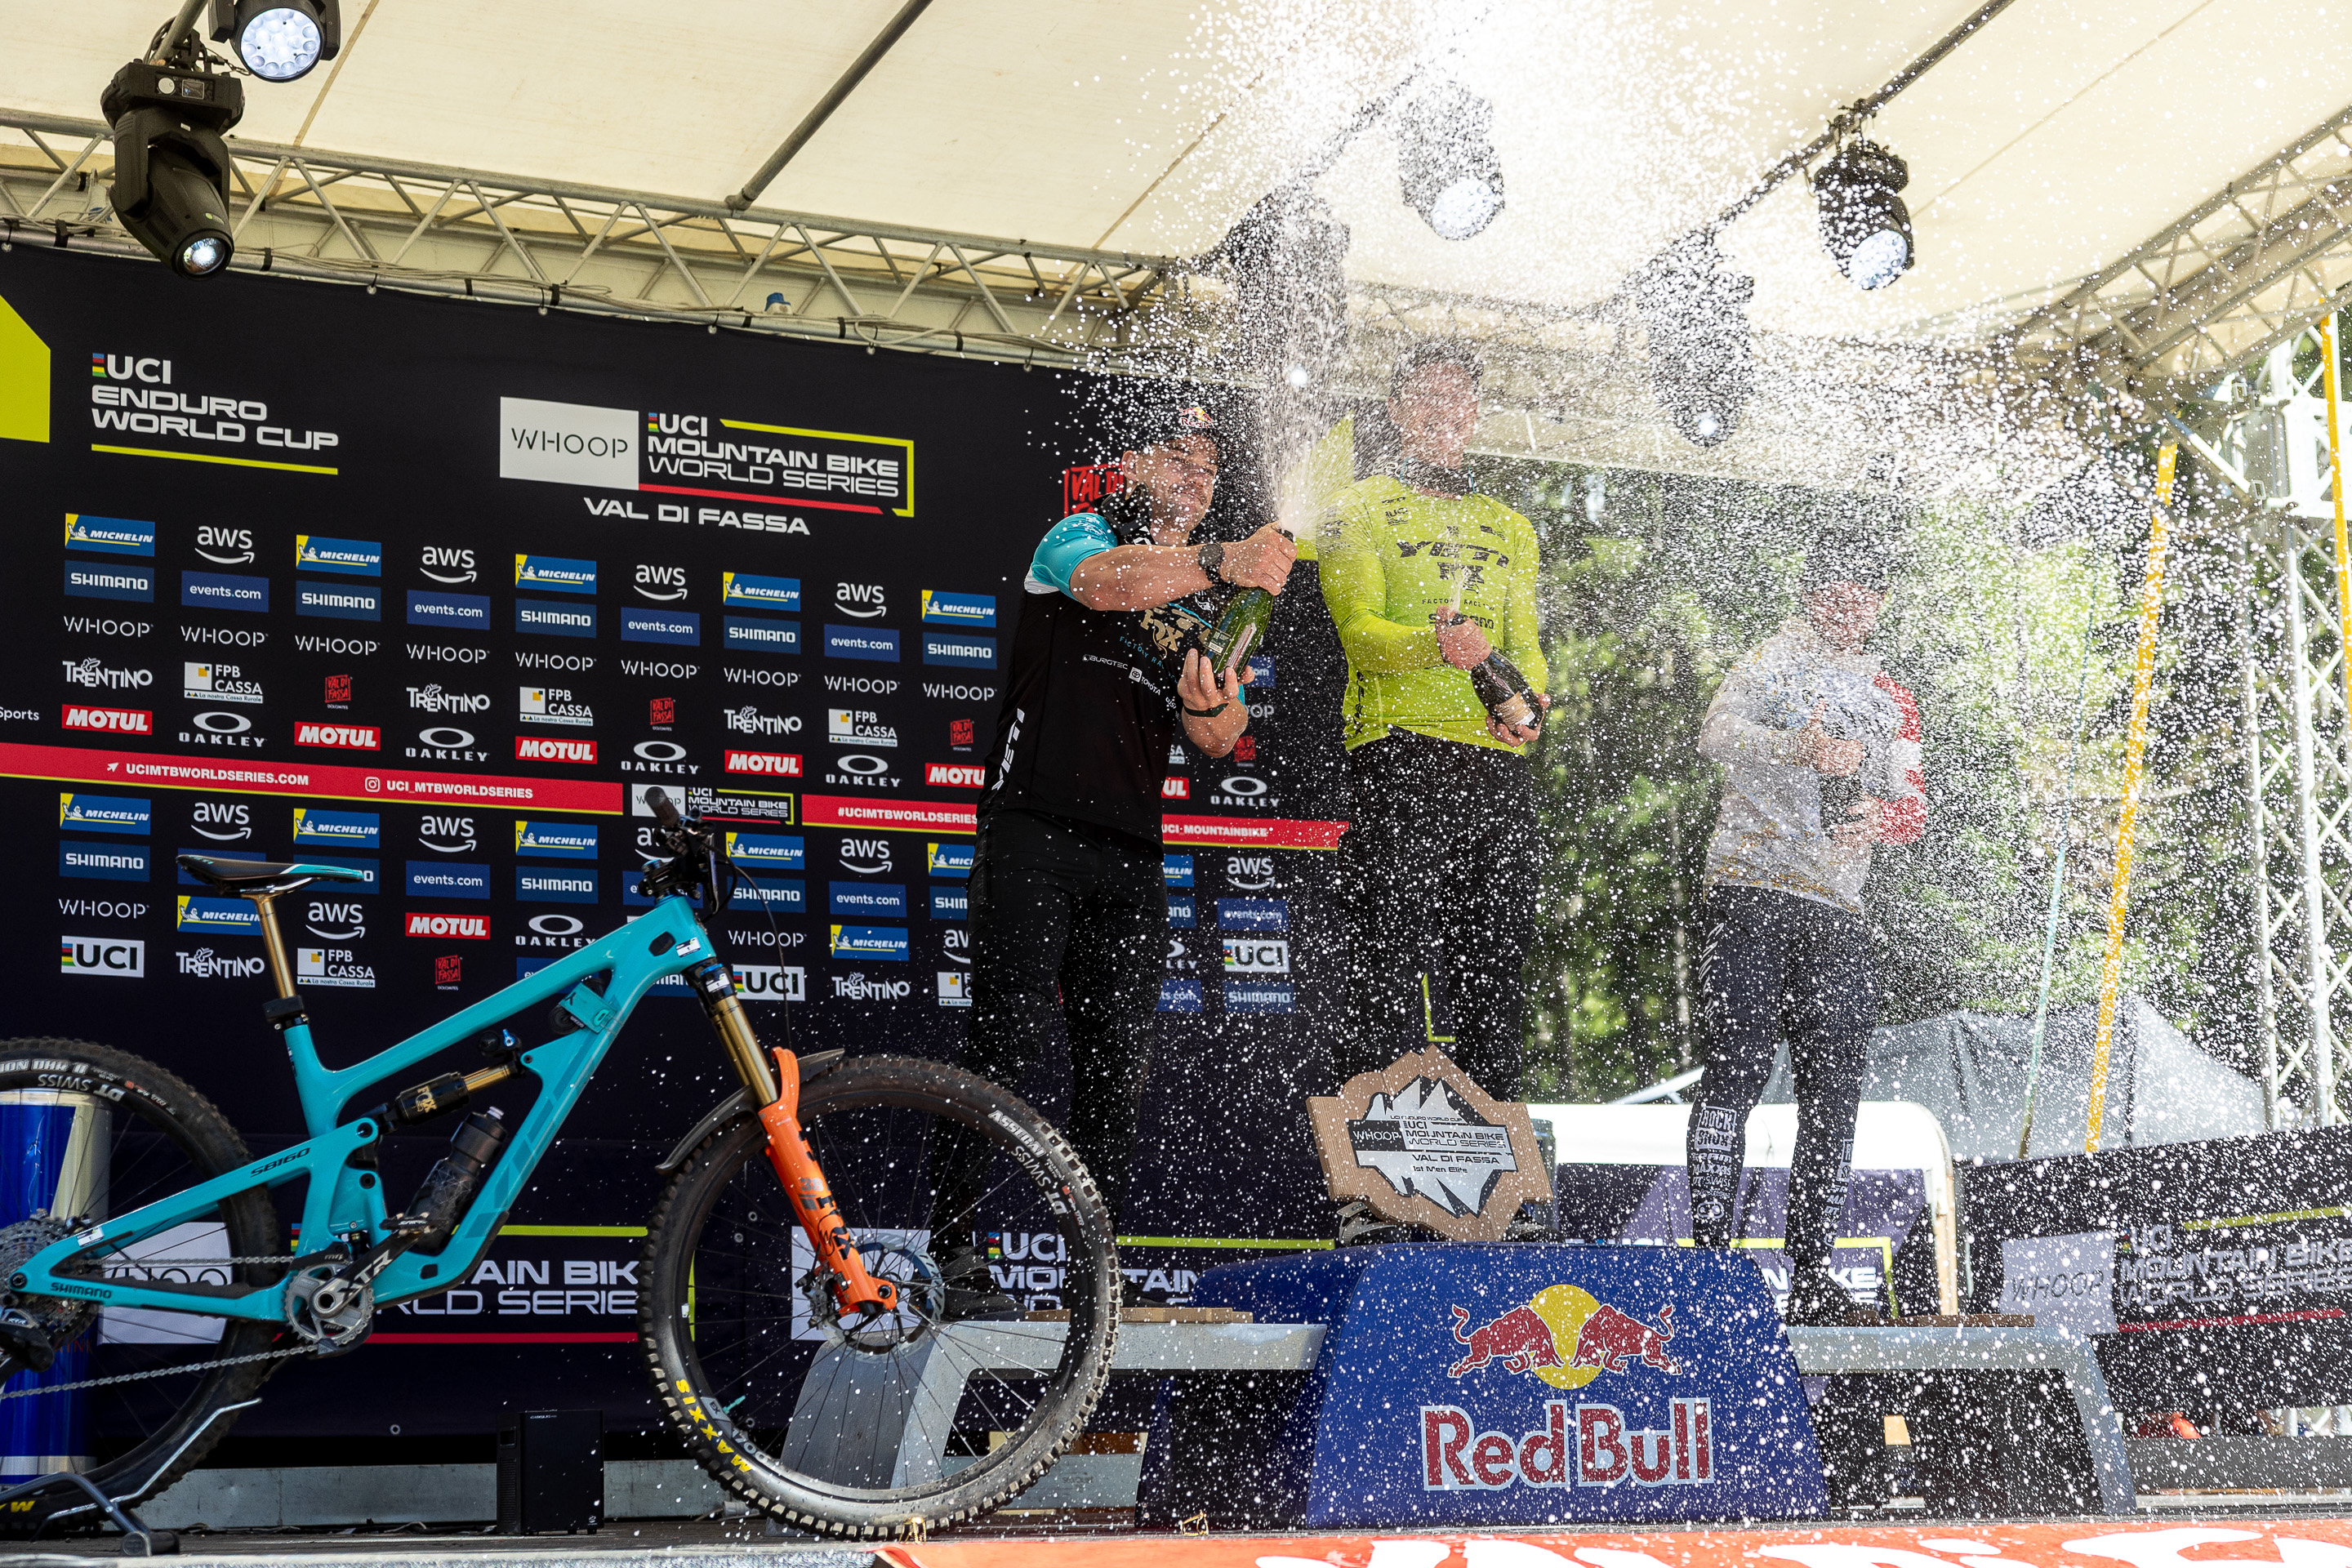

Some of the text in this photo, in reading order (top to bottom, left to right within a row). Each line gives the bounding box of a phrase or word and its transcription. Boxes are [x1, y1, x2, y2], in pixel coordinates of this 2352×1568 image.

[106, 354, 172, 384] UCI
[91, 384, 267, 421] ENDURO
[91, 408, 339, 451] WORLD CUP
[659, 413, 707, 437] UCI
[510, 427, 629, 459] WHOOP
[648, 435, 899, 477] MOUNTAIN BIKE
[648, 456, 899, 497] WORLD SERIES
[583, 497, 811, 536] VAL DI FASSA
[90, 529, 153, 543] MICHELIN
[197, 525, 252, 550] aws
[319, 550, 380, 564] MICHELIN
[421, 546, 474, 568] aws
[70, 572, 148, 590] SHIMANO
[538, 568, 595, 581] MICHELIN
[635, 564, 685, 586] aws
[189, 585, 261, 600] events.com
[301, 592, 376, 609] SHIMANO
[744, 587, 799, 599] MICHELIN
[836, 582, 884, 604] aws
[414, 603, 483, 618] events.com
[521, 610, 591, 626] SHIMANO
[942, 604, 995, 616] MICHELIN
[63, 616, 150, 638] WHOOP
[180, 625, 266, 647] WHOOP
[628, 620, 693, 635] events.com
[728, 627, 795, 644] SHIMANO
[294, 635, 377, 655] WHOOP
[831, 636, 893, 650] events.com
[928, 643, 991, 658] SHIMANO
[406, 644, 487, 664] WHOOP
[515, 652, 594, 671] WHOOP
[1089, 655, 1129, 670] BURGTEC
[62, 661, 153, 689] TRENTINO
[216, 664, 241, 678] FPB
[621, 659, 698, 679] WHOOP
[724, 667, 798, 687] WHOOP
[215, 679, 263, 695] CASSA
[824, 675, 898, 694] WHOOP
[923, 683, 995, 702] WHOOP
[406, 686, 490, 714] TRENTINO
[548, 688, 572, 702] FPB
[0, 706, 39, 720] Sports
[548, 703, 593, 718] CASSA
[855, 710, 877, 723] FPB
[66, 709, 148, 731] MOTUL
[724, 708, 801, 735] TRENTINO
[179, 733, 265, 746] OAKLEY
[298, 726, 376, 747] MOTUL
[855, 725, 897, 738] CASSA
[405, 746, 488, 762] OAKLEY
[519, 739, 594, 761] MOTUL
[621, 760, 700, 774] OAKLEY
[728, 754, 800, 773] MOTUL
[126, 764, 309, 786] UCIMTBWORLDSERIES.COM
[826, 774, 901, 788] OAKLEY
[929, 766, 985, 785] MOTU
[386, 780, 533, 800] UCI_MTBWORLDSERIES
[693, 787, 712, 797] UCI
[688, 797, 755, 808] MOUNTAIN
[1210, 795, 1279, 808] OAKLEY
[85, 809, 149, 822] MICHELIN
[193, 802, 250, 825] aws
[742, 808, 787, 817] SERIES
[838, 807, 978, 825] #UCIMTBWORLDSERIES
[317, 823, 378, 835] MICHELIN
[421, 816, 474, 838] aws
[538, 835, 595, 847] MICHELIN
[840, 839, 890, 858] aws
[748, 847, 803, 857] MICHELIN
[65, 853, 144, 870] SHIMANO
[1227, 858, 1273, 875] aws
[413, 873, 483, 887] events.com
[521, 878, 593, 892] SHIMANO
[733, 888, 800, 902] SHIMANO
[836, 894, 900, 907] events.com
[935, 898, 967, 909] SHIM
[58, 898, 147, 920] WHOOP
[308, 902, 363, 924] aws
[409, 916, 486, 936] MOTUL
[728, 930, 804, 947] WHOOP
[853, 938, 907, 949] MICHELIN
[76, 944, 137, 971] UCI
[176, 951, 265, 978] TRENTINO
[327, 949, 353, 962] FPB
[1236, 946, 1283, 966] UCI
[327, 964, 375, 978] CASSA
[746, 972, 799, 995] UCI
[832, 976, 910, 1001] TRENTINO
[1228, 991, 1290, 1004] SHIMANO
[38, 1074, 93, 1091] SWISS
[94, 1084, 127, 1102] DT
[1408, 1121, 1427, 1129] UCI
[1352, 1131, 1400, 1141] WHOOP
[1405, 1130, 1472, 1139] MOUNTAIN
[1409, 1138, 1457, 1147] WORLD
[251, 1147, 311, 1178] SB160
[800, 1178, 824, 1192] 38
[1011, 1145, 1067, 1215] DT SWISS
[1002, 1232, 1066, 1261] UCI
[564, 1260, 639, 1285] BIK
[51, 1281, 112, 1299] SHIMANO
[2011, 1271, 2105, 1303] WHOOP
[498, 1290, 639, 1316] SERIE
[675, 1379, 753, 1472] MAXXIS
[1421, 1397, 1714, 1490] Red Bull
